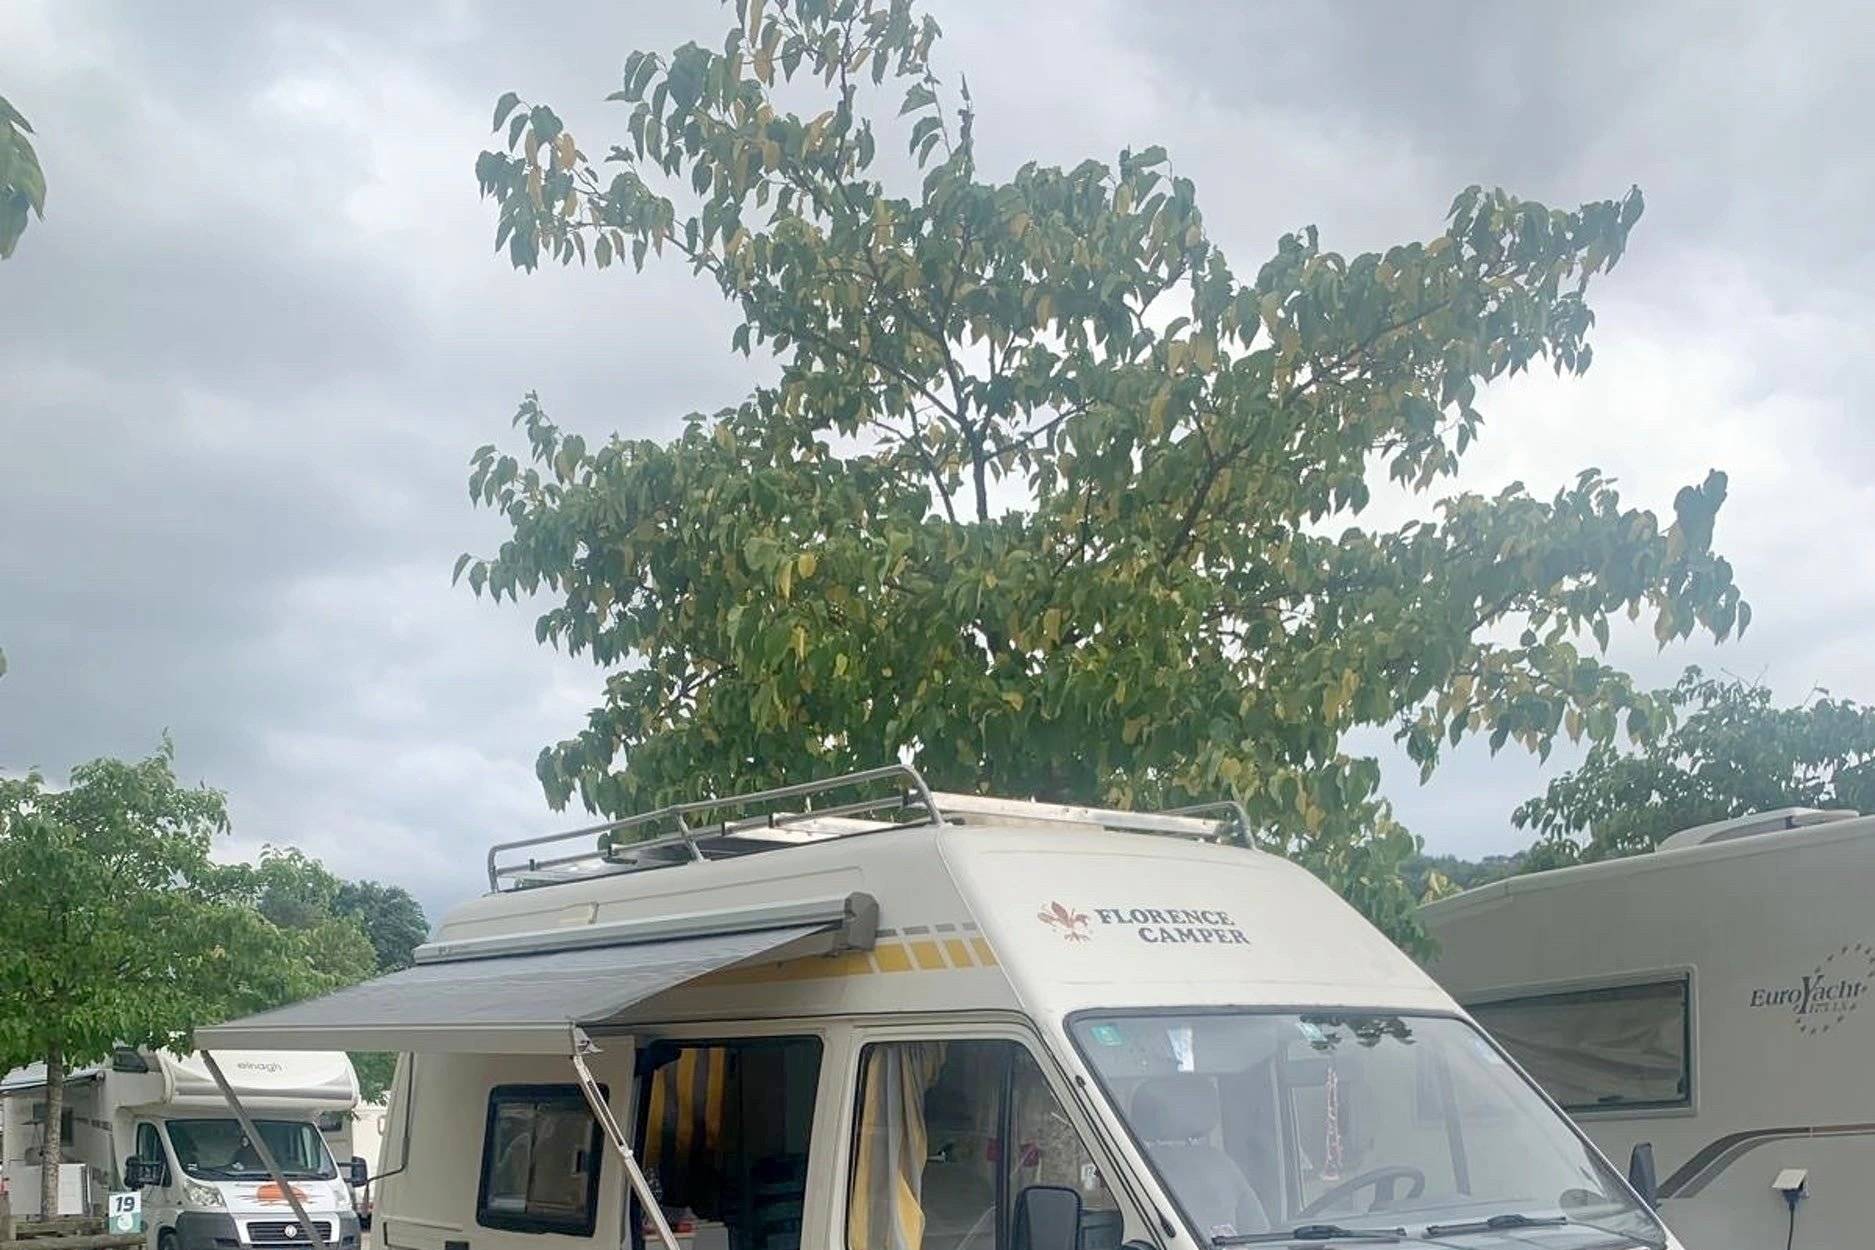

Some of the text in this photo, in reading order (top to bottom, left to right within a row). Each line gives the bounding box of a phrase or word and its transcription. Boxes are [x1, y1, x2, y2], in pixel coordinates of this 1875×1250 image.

[1094, 908, 1235, 926] FLORENCE
[1138, 927, 1251, 945] CAMPER
[1750, 974, 1861, 1015] EuroYacht
[115, 1196, 135, 1212] 19
